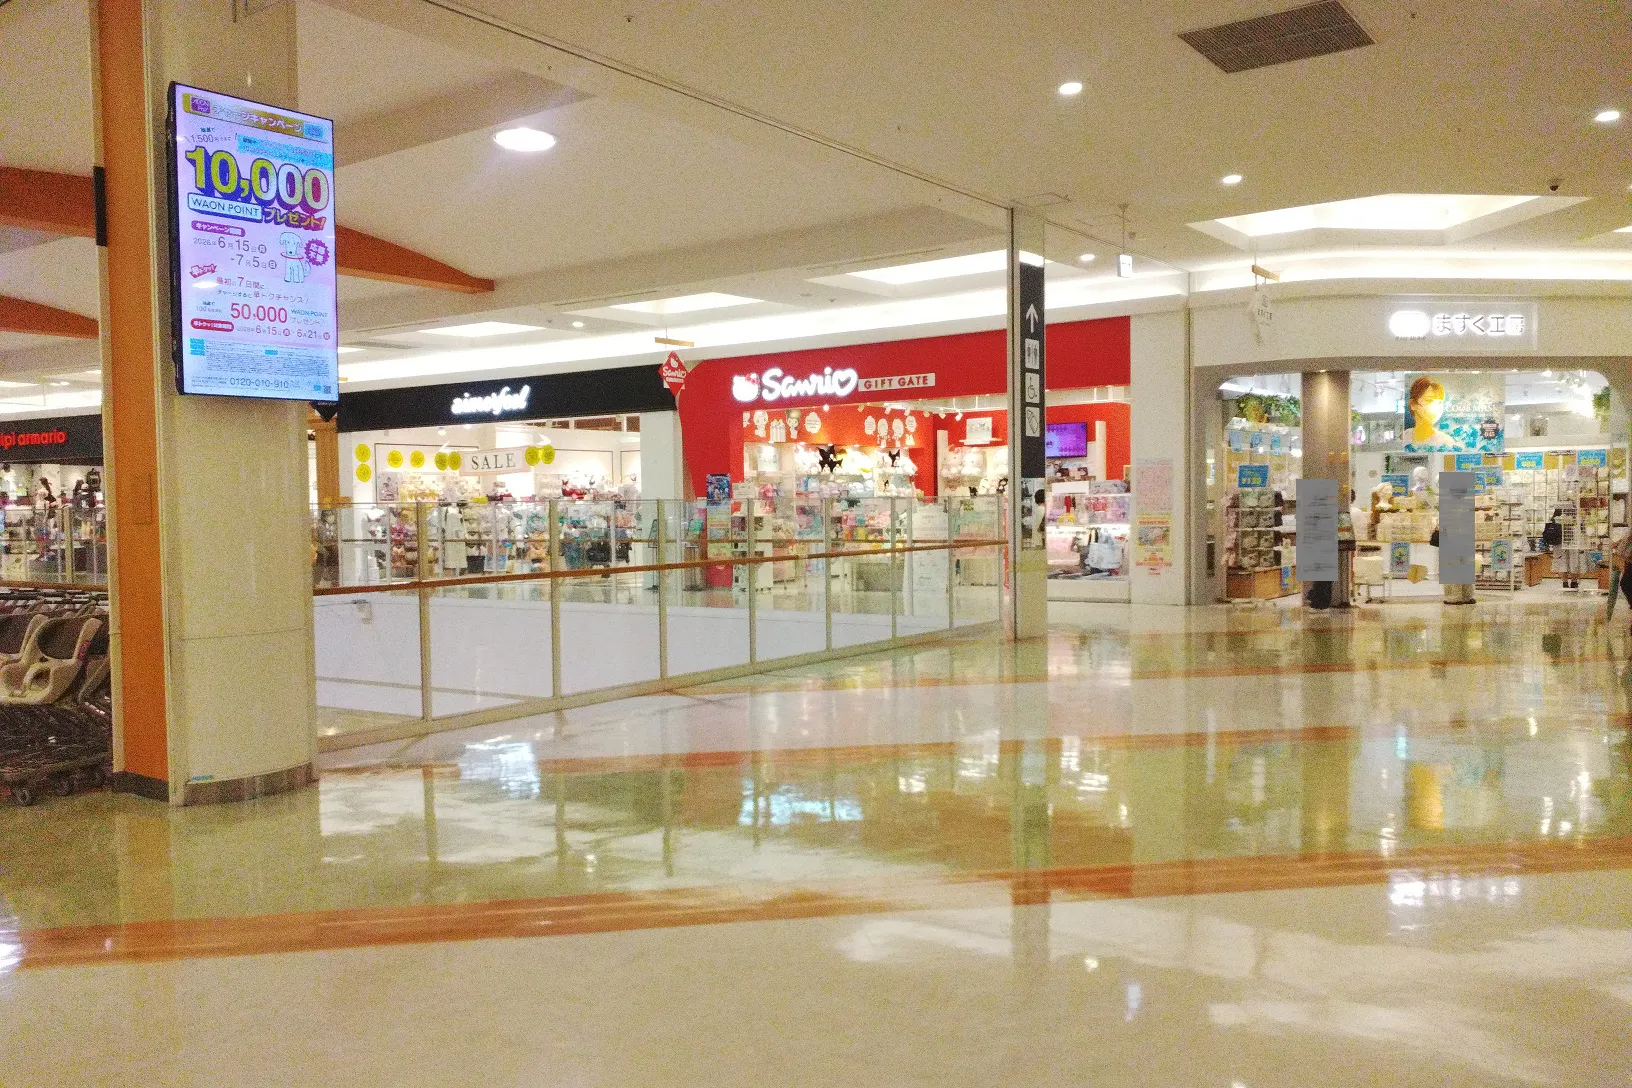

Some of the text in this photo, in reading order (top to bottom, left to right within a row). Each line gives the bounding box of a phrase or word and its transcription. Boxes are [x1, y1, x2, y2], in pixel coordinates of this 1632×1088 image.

[185, 146, 329, 211] 10,000
[191, 197, 260, 217] WAON POINT
[230, 302, 288, 323] 50,000
[229, 377, 289, 389] 0120-010-910
[761, 366, 858, 401] Sanrio
[864, 375, 929, 390] GIFT GATE
[471, 452, 516, 471] SALE
